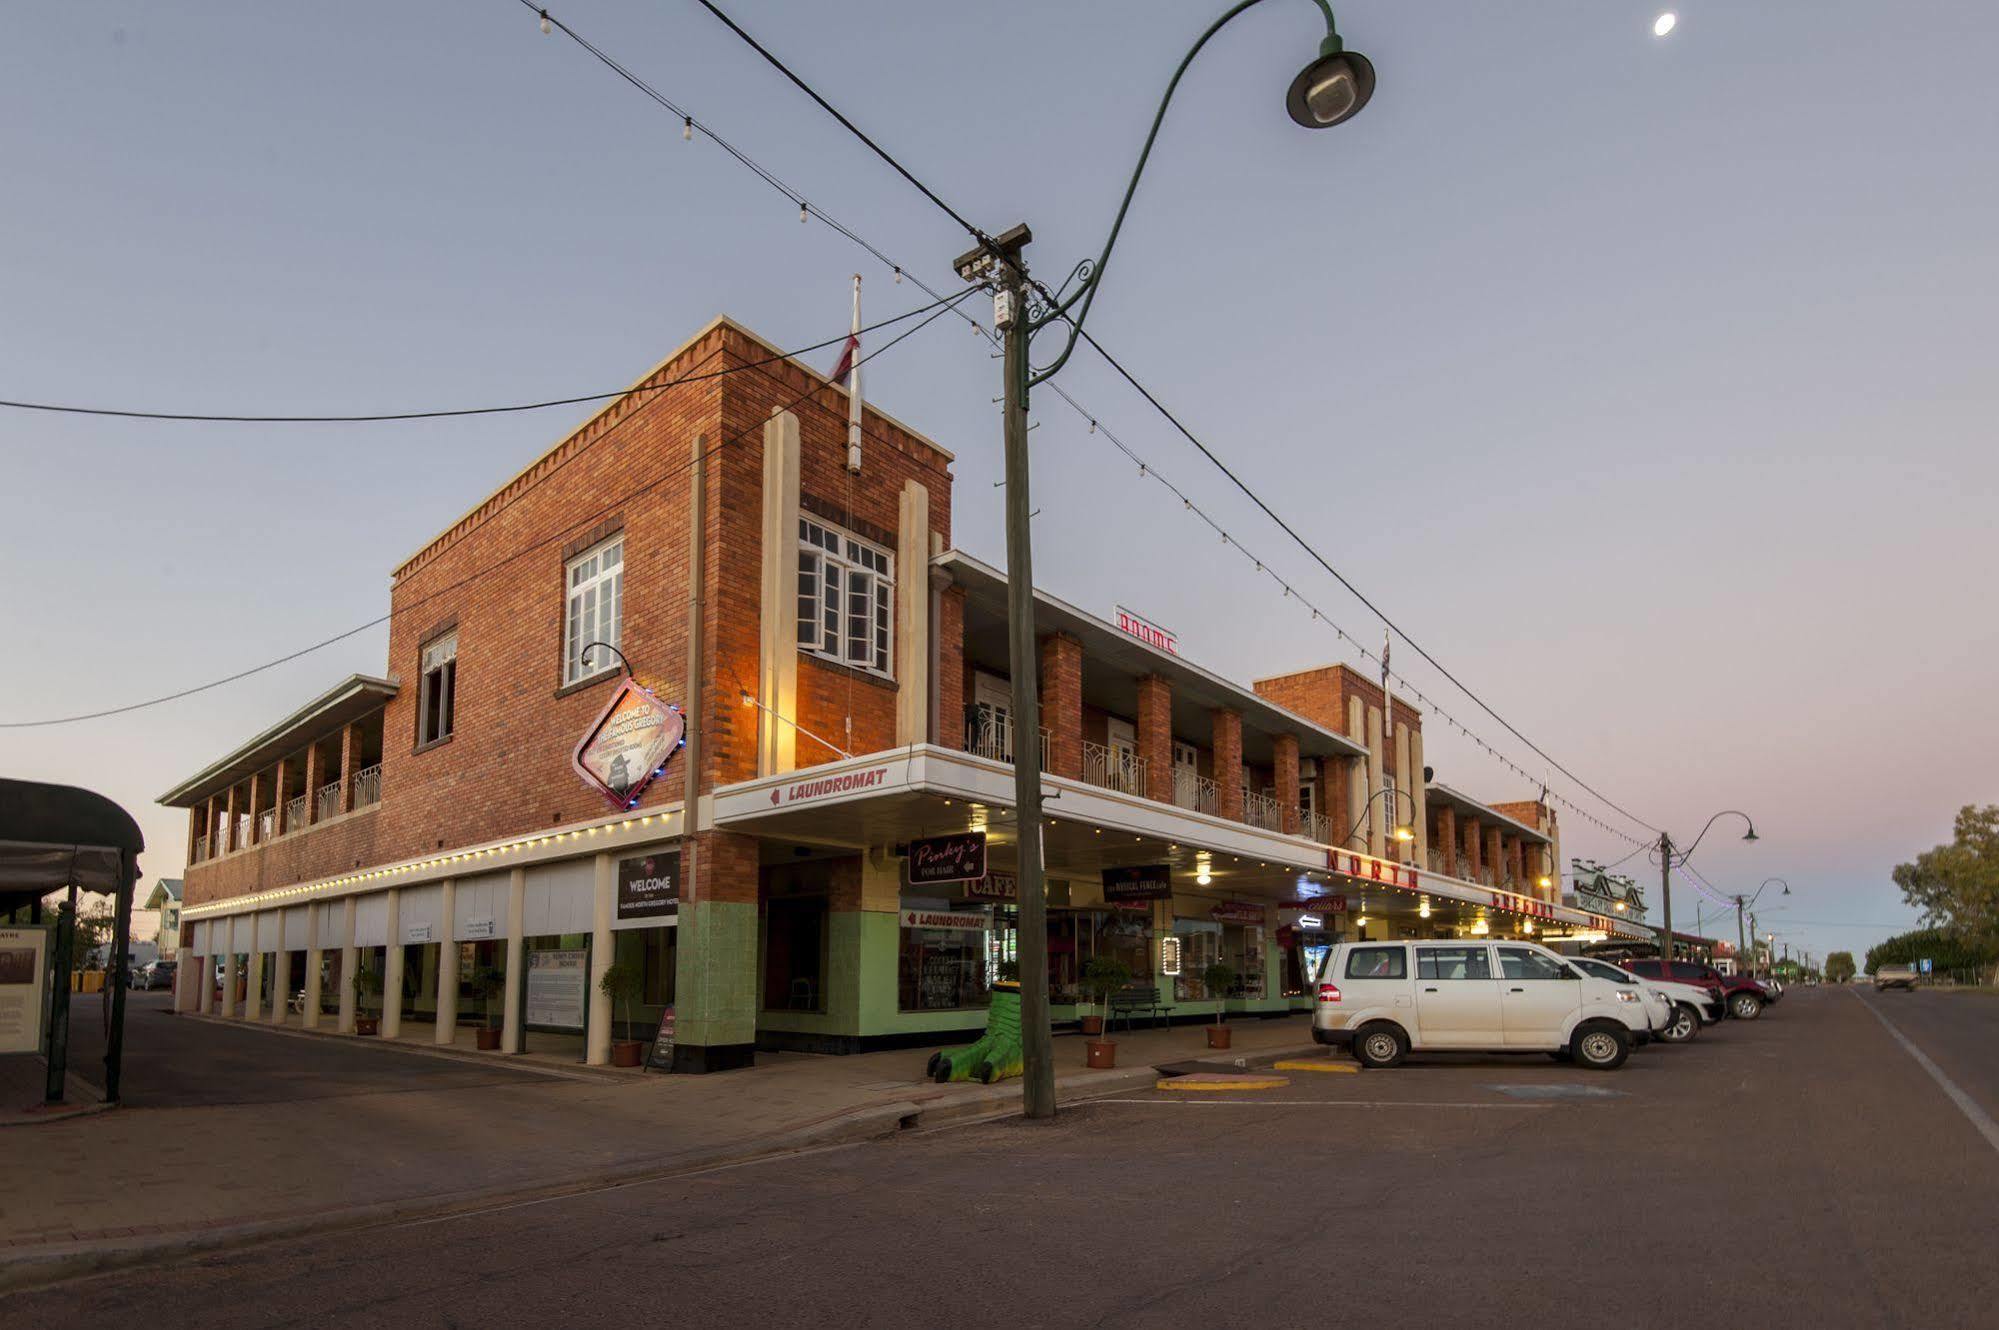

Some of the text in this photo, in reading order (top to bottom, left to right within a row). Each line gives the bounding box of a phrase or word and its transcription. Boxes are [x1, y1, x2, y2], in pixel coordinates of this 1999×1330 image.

[611, 706, 642, 726] WELCOME
[634, 712, 665, 730] GREGORY
[788, 768, 888, 801] LAUNDROMAT
[913, 840, 980, 866] Pinky's
[1326, 848, 1418, 889] NORTH
[629, 876, 671, 892] WELCOME
[970, 875, 1017, 898] CAFE
[918, 912, 985, 928] LAUNDROMAT
